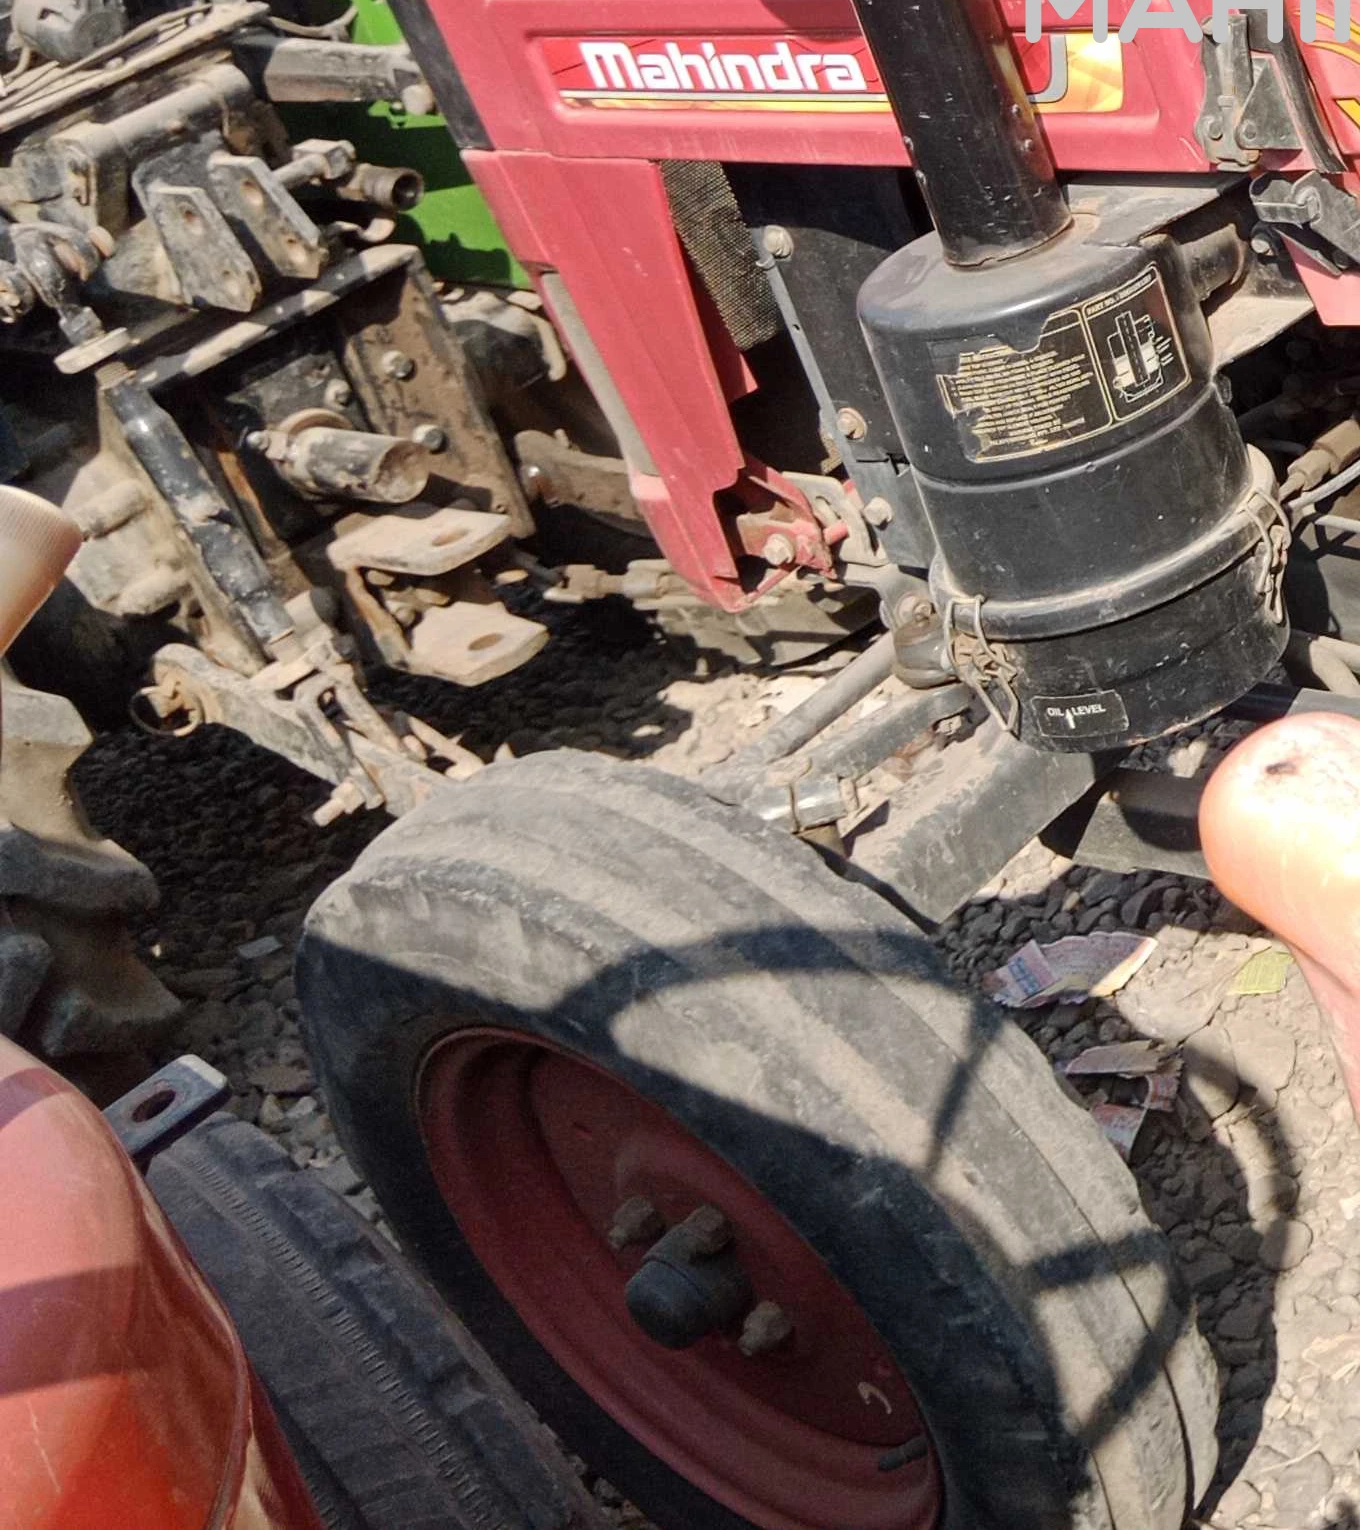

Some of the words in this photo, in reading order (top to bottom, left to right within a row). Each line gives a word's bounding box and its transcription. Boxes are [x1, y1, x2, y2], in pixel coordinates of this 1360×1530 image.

[579, 42, 866, 90] Mahindra
[1047, 707, 1065, 717] OIL
[1072, 703, 1106, 716] LEVEL
